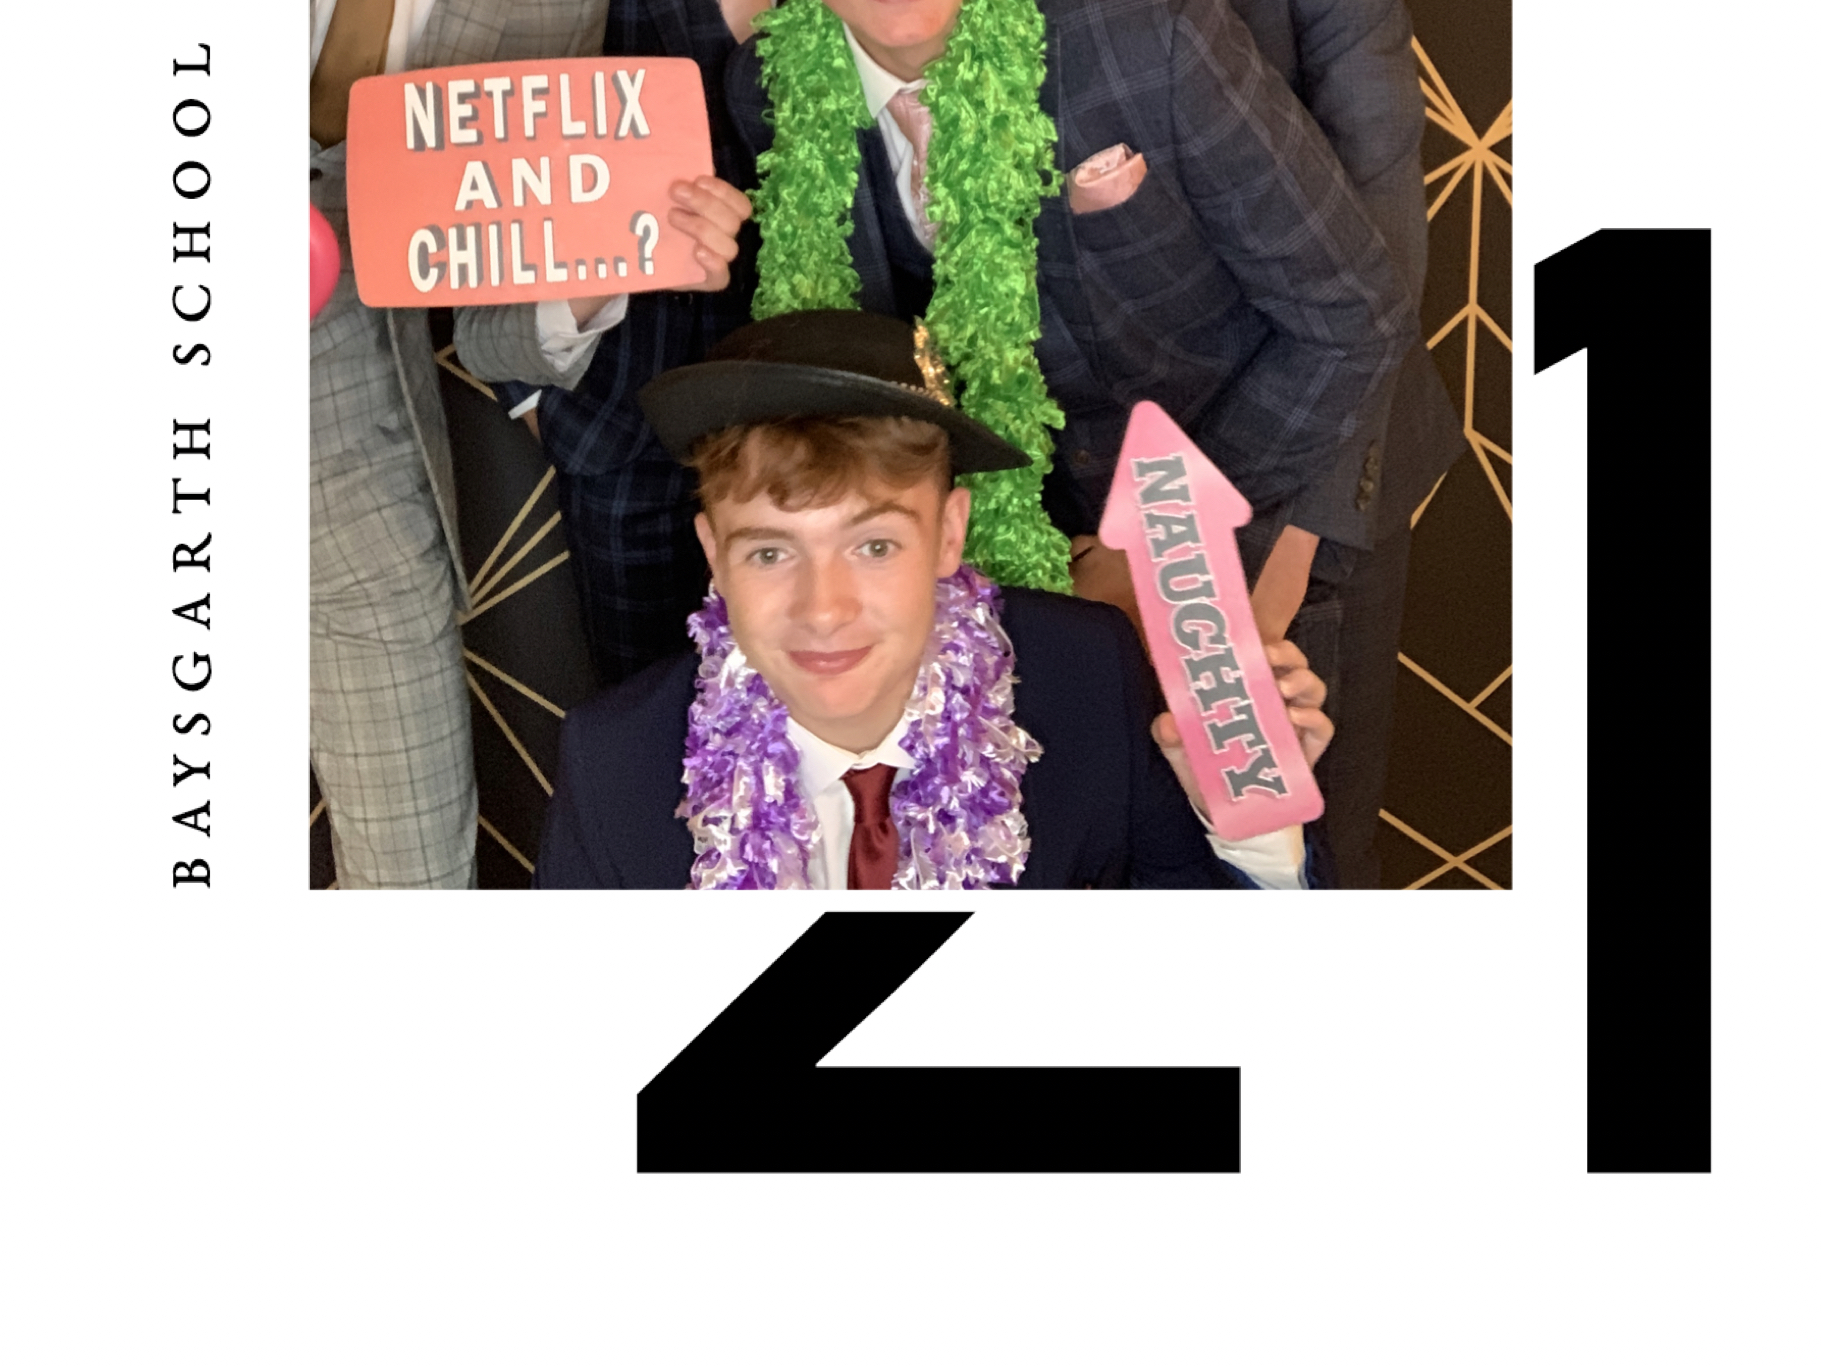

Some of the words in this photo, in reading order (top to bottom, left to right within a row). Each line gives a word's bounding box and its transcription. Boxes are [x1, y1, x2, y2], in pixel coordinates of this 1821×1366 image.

[403, 68, 651, 152] NETFLIX
[455, 153, 611, 211] AND
[407, 210, 660, 293] CHILL...?
[1130, 452, 1291, 802] NAUGHTY
